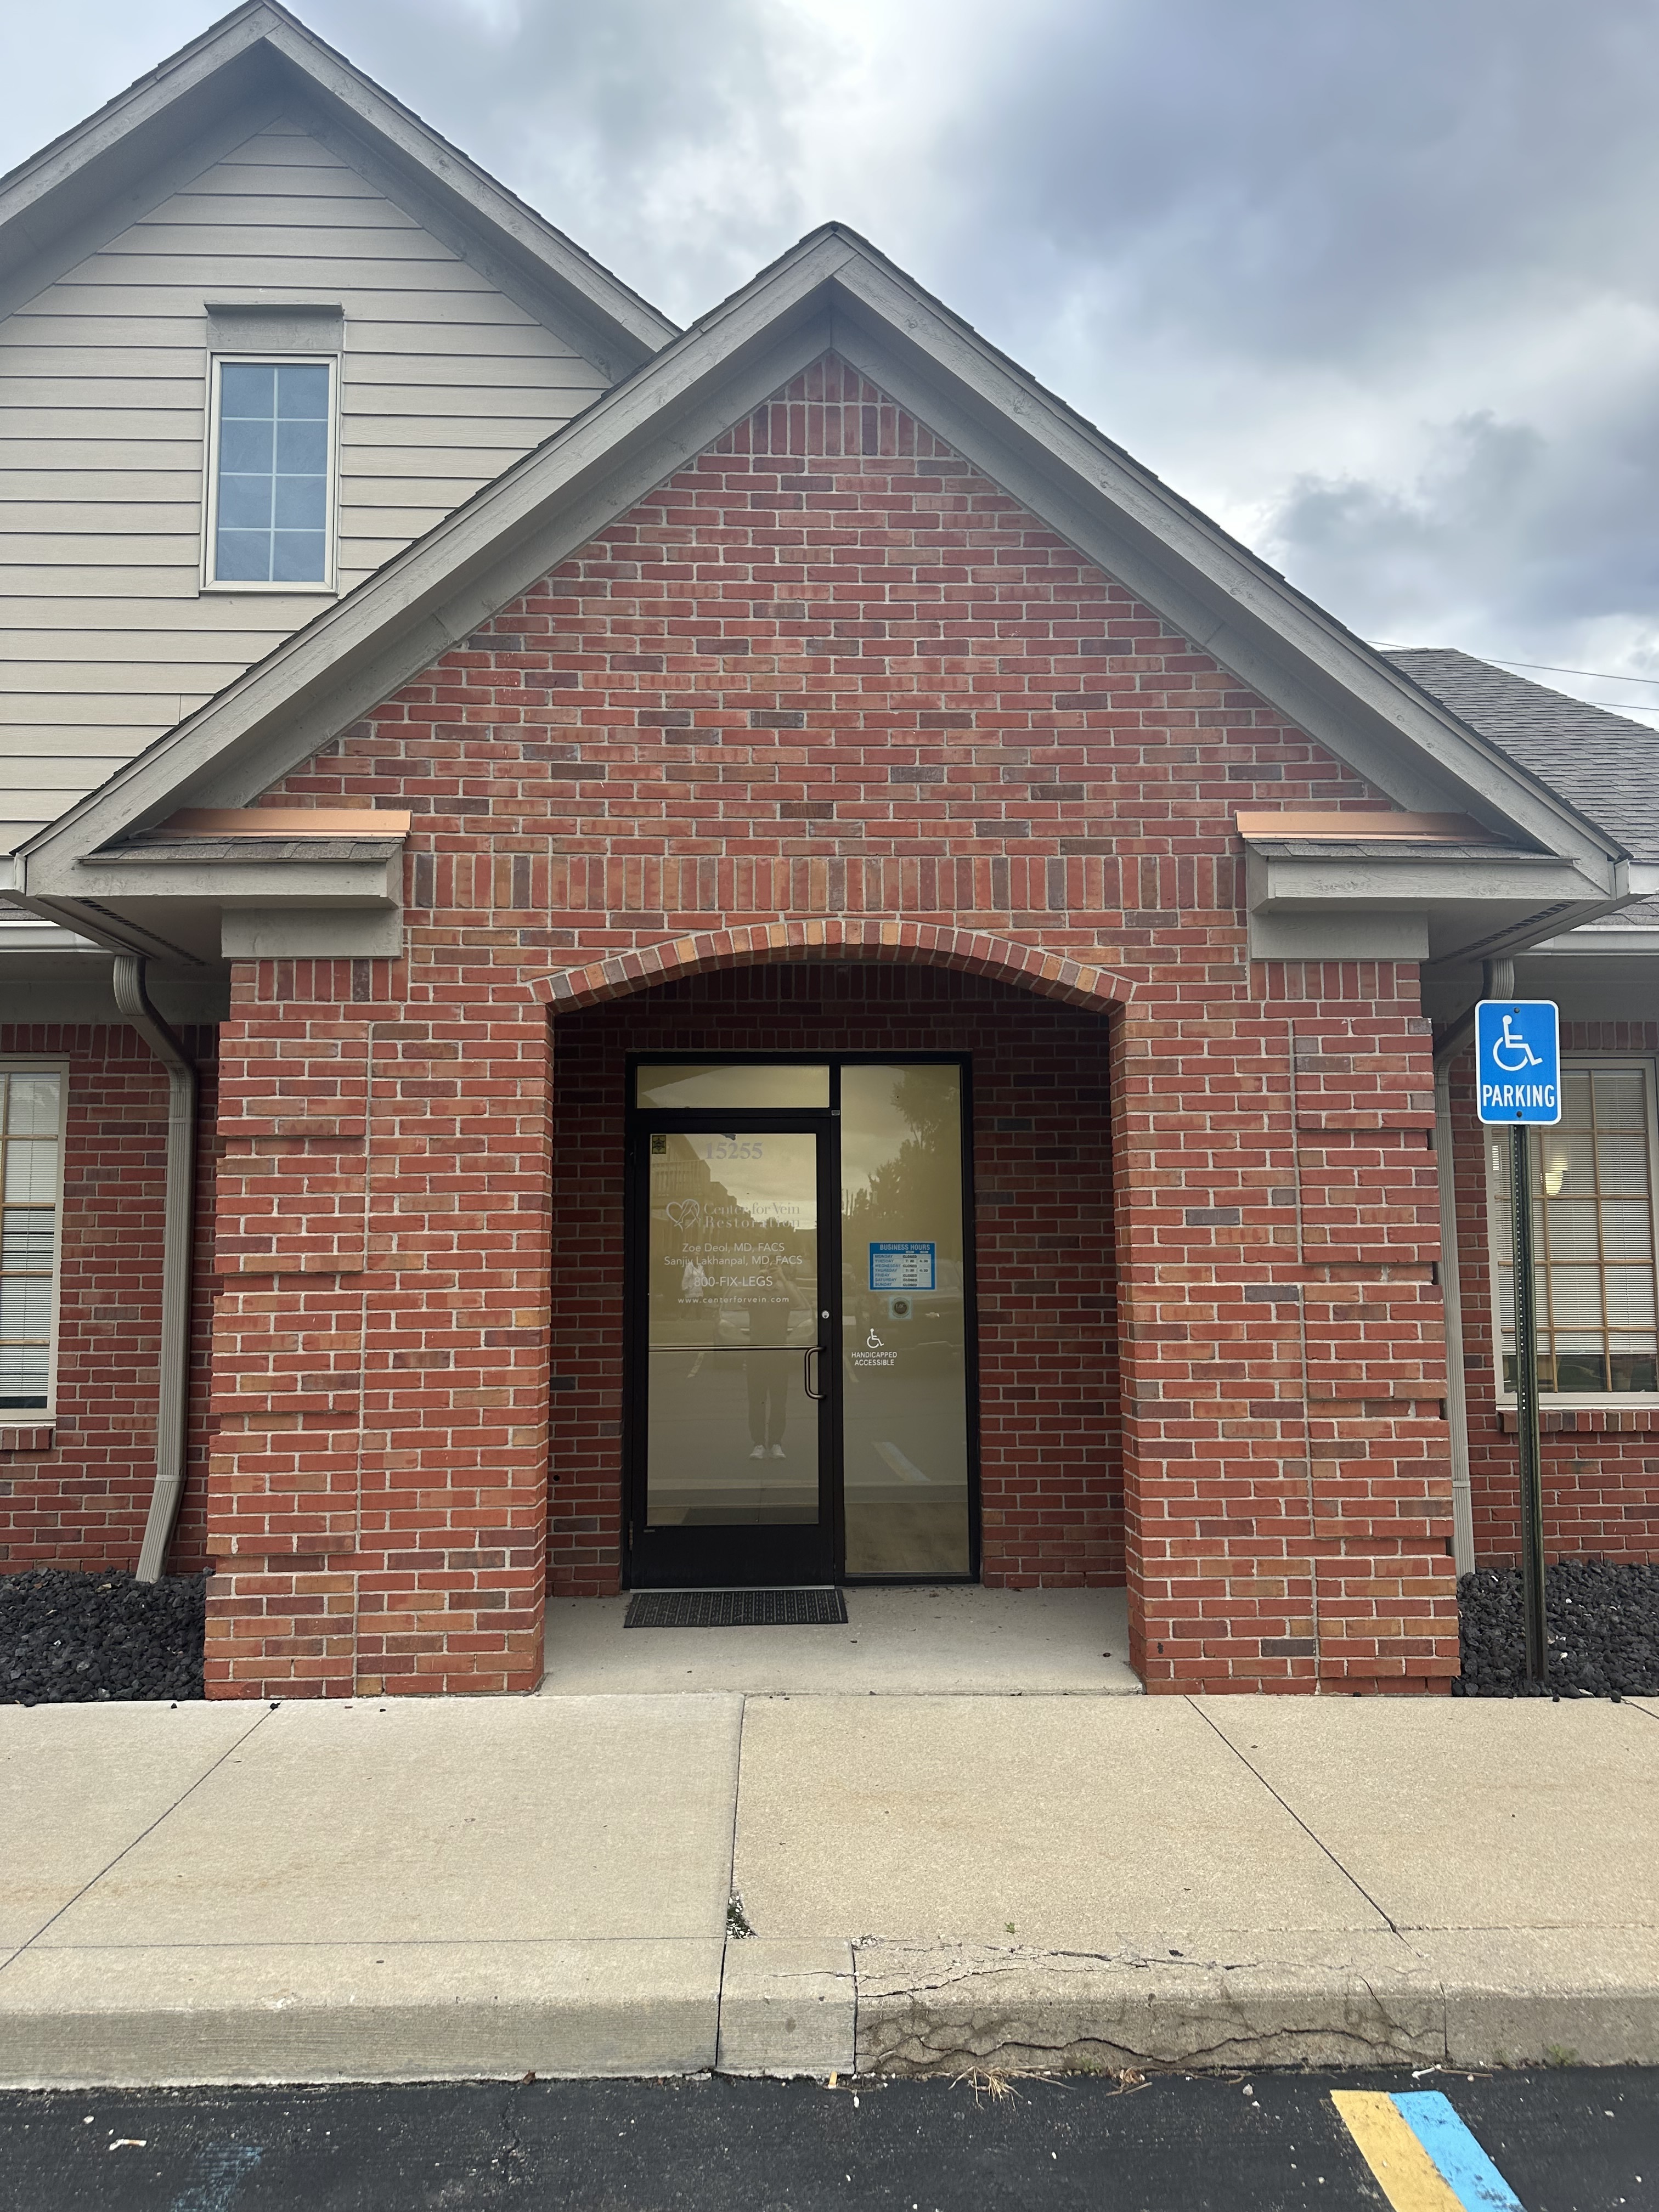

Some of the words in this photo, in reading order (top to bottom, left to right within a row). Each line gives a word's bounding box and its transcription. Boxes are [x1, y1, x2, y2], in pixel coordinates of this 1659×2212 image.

[1482, 1085, 1555, 1108] PARKING
[706, 1142, 763, 1159] 15255
[704, 1202, 749, 1215] Center
[752, 1202, 769, 1215] for
[771, 1202, 801, 1215] Vein
[705, 1216, 800, 1228] Restoration
[682, 1243, 701, 1252] Zoe
[704, 1243, 731, 1253] Deol,
[734, 1243, 755, 1253] MD,
[758, 1242, 785, 1252] FACS
[664, 1256, 693, 1267] Sanjiv
[696, 1255, 748, 1267] Lakhanpal,
[752, 1255, 772, 1266] MD,
[776, 1255, 803, 1265] FACS
[694, 1276, 773, 1286] 800-FIX-LEGS
[678, 1295, 789, 1304] www.centerforvein.com
